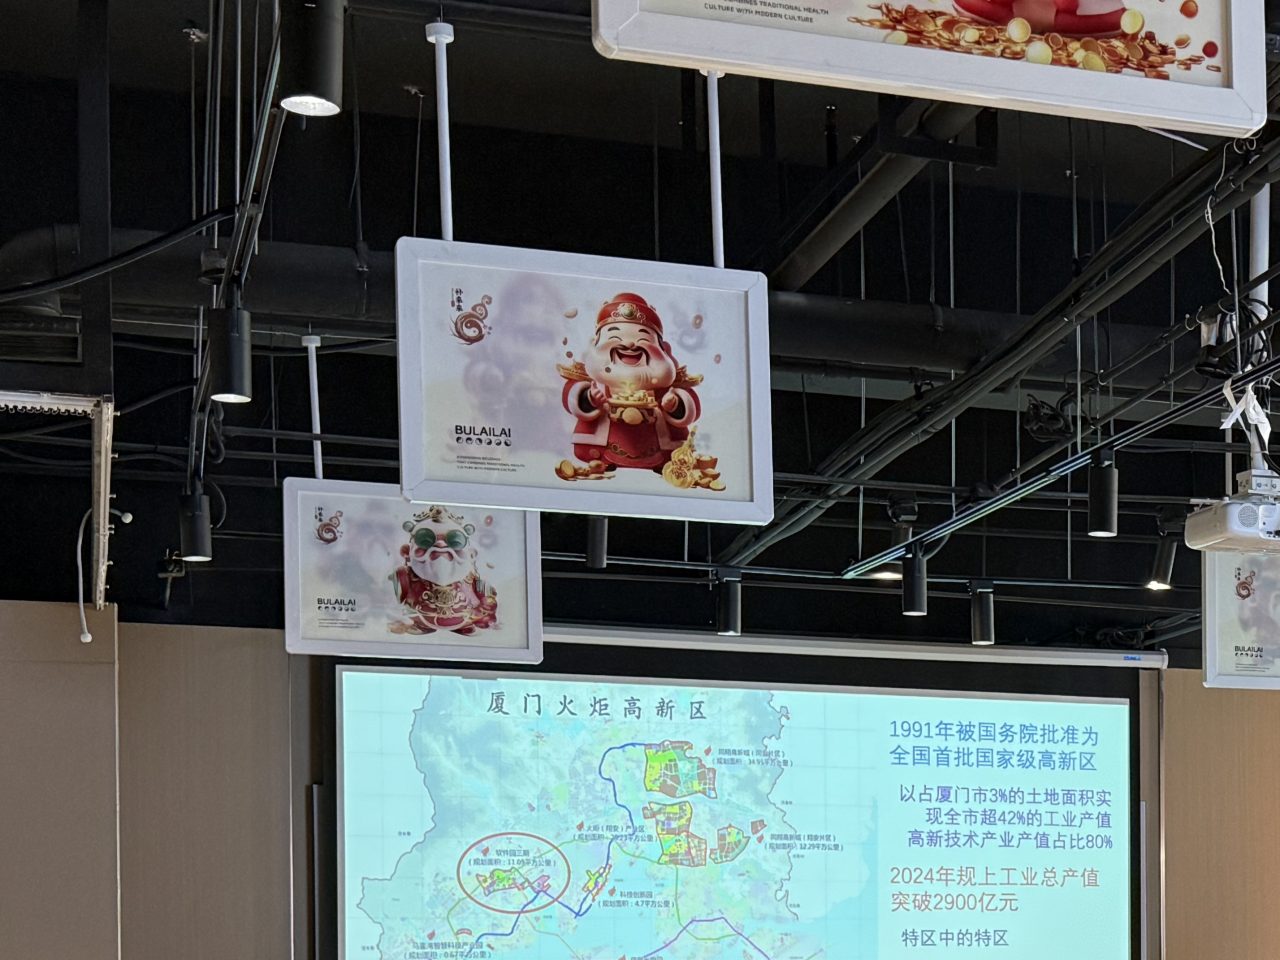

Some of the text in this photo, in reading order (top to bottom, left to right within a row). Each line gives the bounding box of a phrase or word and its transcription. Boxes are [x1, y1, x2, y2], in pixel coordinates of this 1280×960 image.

[704, 3, 735, 12] CULTURE
[754, 10, 783, 19] MODERN
[784, 12, 814, 23] CULTURE
[803, 7, 829, 15] HEALTH
[455, 424, 511, 438] BULAILAI
[317, 598, 356, 606] BULAILAI
[486, 690, 707, 721] 厦门火炬高新区
[889, 720, 1099, 746] 1991年被国务院批准为
[889, 746, 1097, 771] 全国首批国家级高新区
[899, 784, 1112, 807] 以占厦门市3%的土地面积实
[925, 807, 1112, 829] 现全市超42%的工业产值
[907, 829, 1113, 850] 高新技术产业产值占比80%
[890, 866, 1100, 889] 2024年规上工业总产值
[891, 891, 1019, 913] 突破2900亿元
[901, 928, 1009, 948] 特区中的特区
